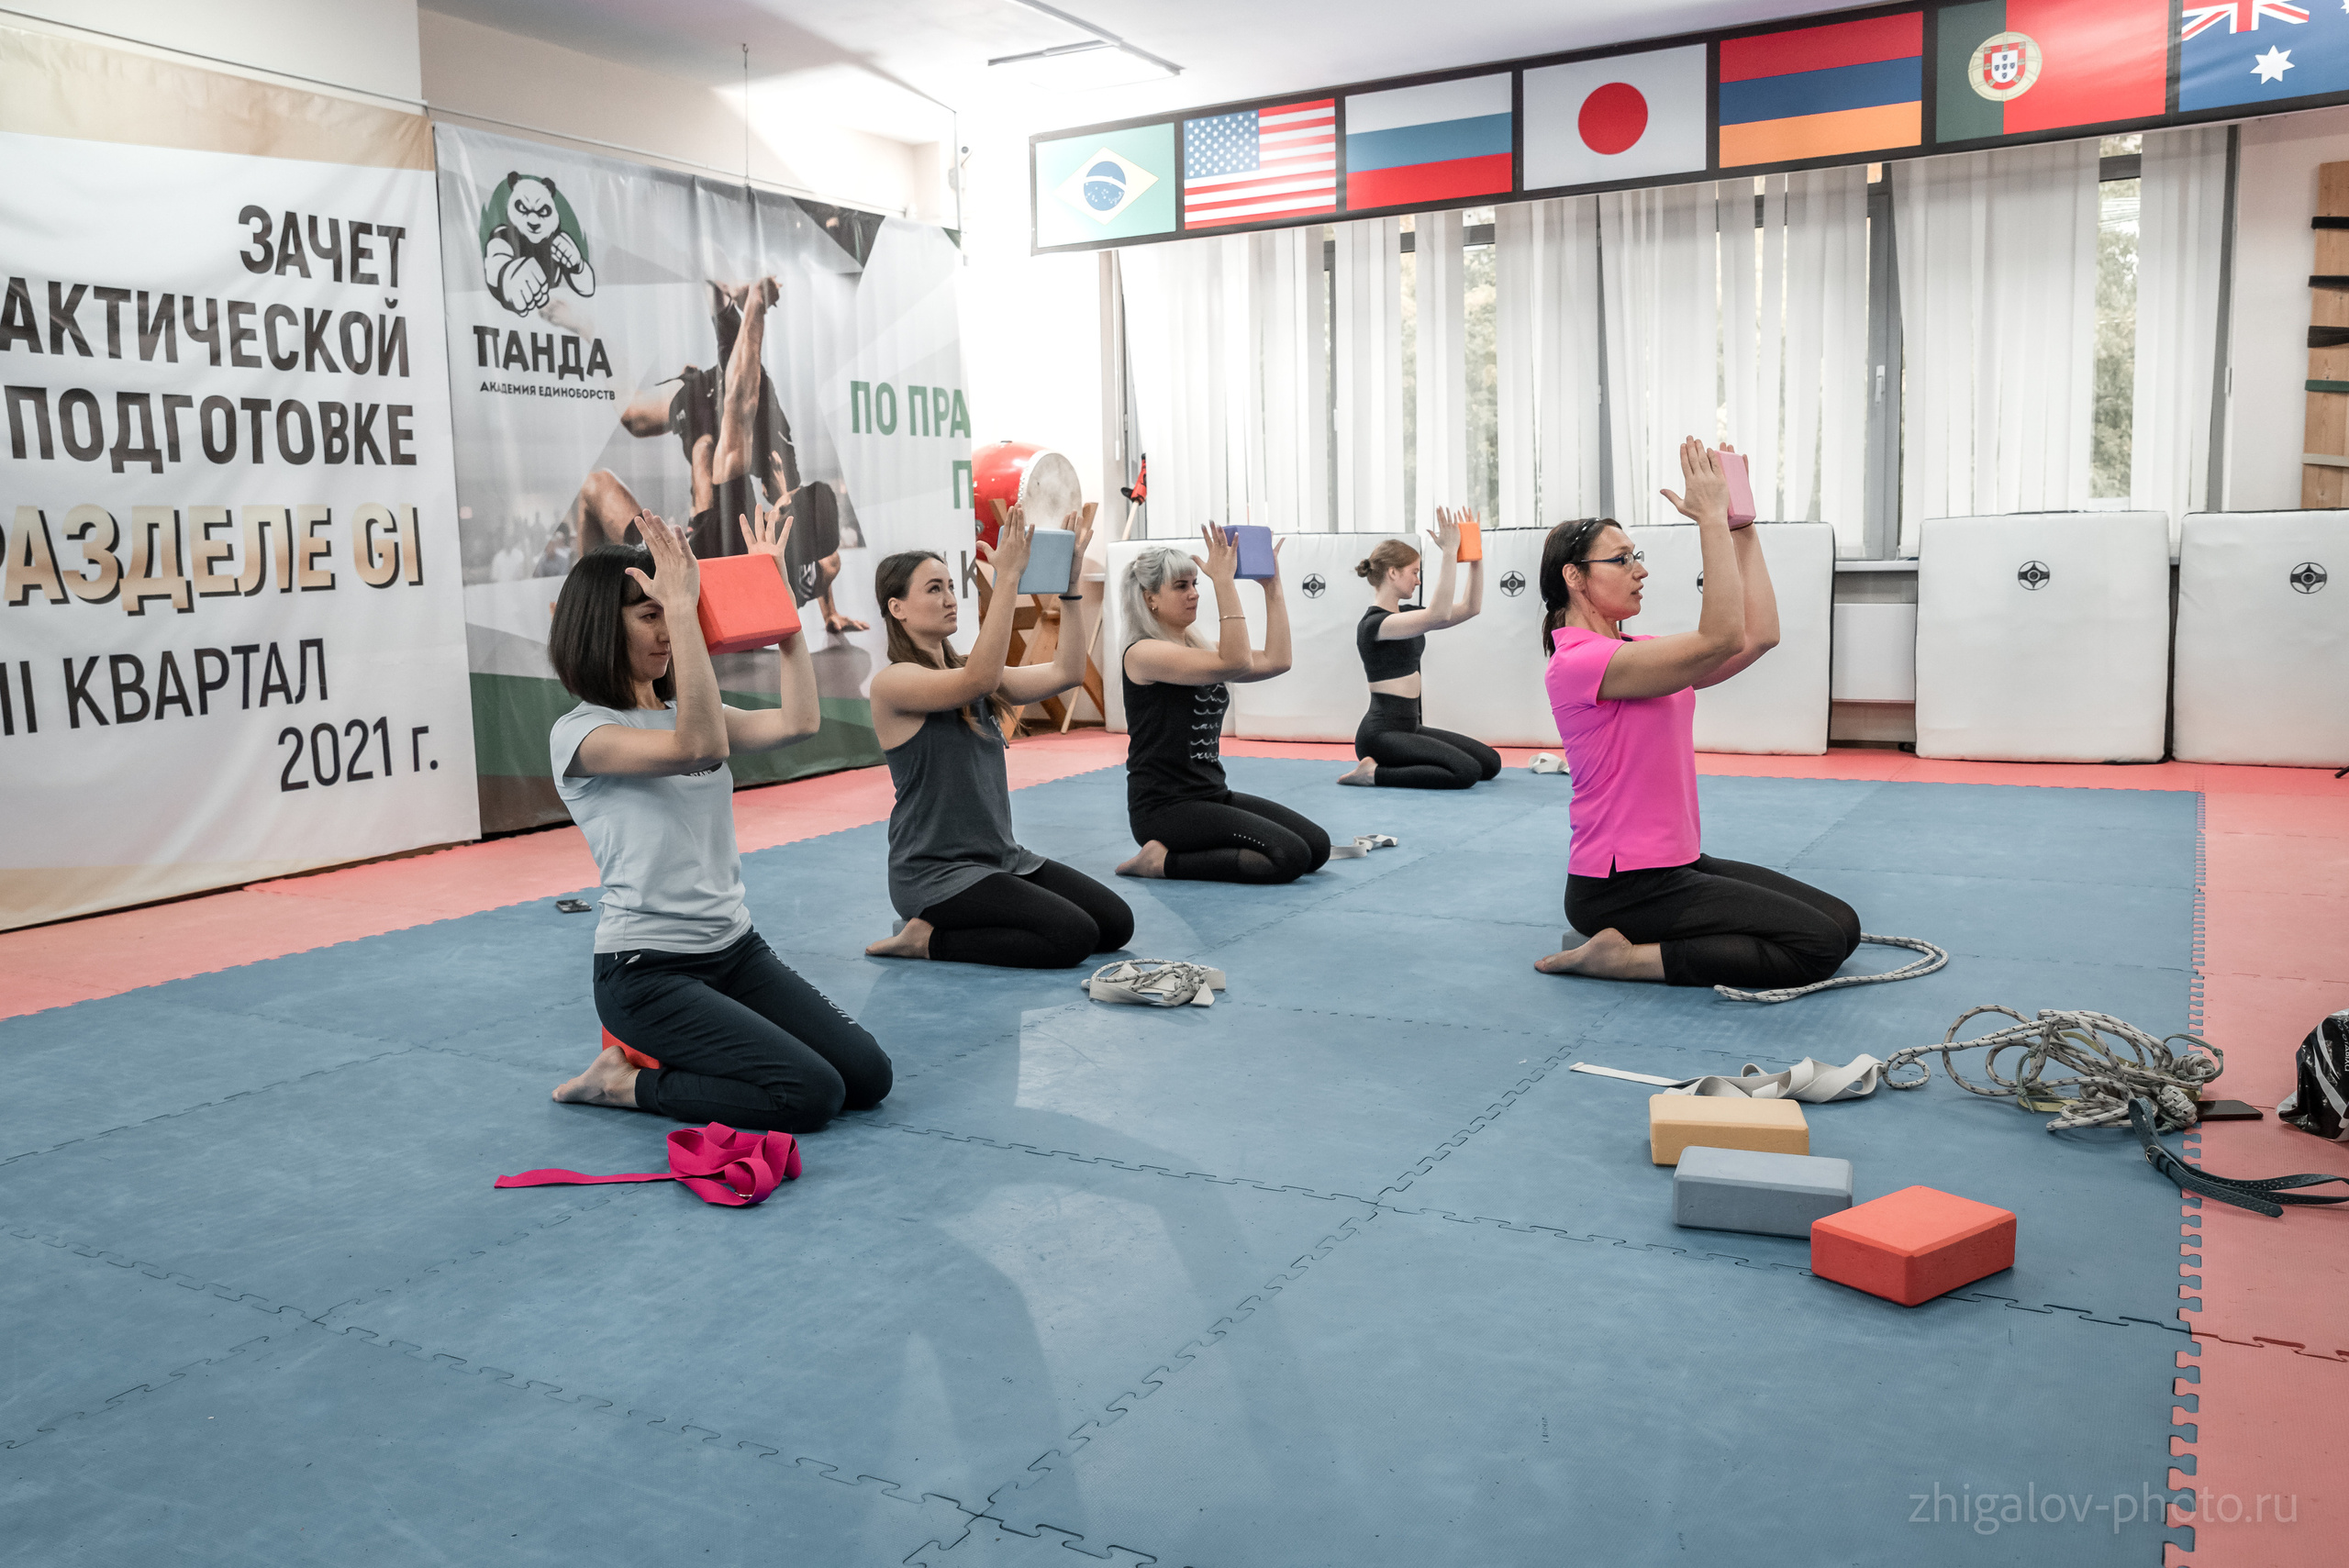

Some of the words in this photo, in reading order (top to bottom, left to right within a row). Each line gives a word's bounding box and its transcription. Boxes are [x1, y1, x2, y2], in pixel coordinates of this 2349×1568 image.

[239, 205, 406, 287] ЗАЧЕТ
[0, 276, 410, 377] АКТИЧЕСКОЙ
[473, 325, 613, 382] ПАНДА
[4, 385, 417, 473] ПОДГОТОВКЕ
[480, 381, 537, 395] АКАДЕМИЯ
[539, 385, 616, 400] ЕДИНОБОРСТВ
[850, 380, 897, 436] ПО
[907, 385, 972, 439] ПРА
[0, 503, 336, 617] АЗДЕЛЕ
[352, 502, 423, 588] GI
[62, 638, 328, 729] КВАРТАЛ
[278, 717, 392, 792] 2021
